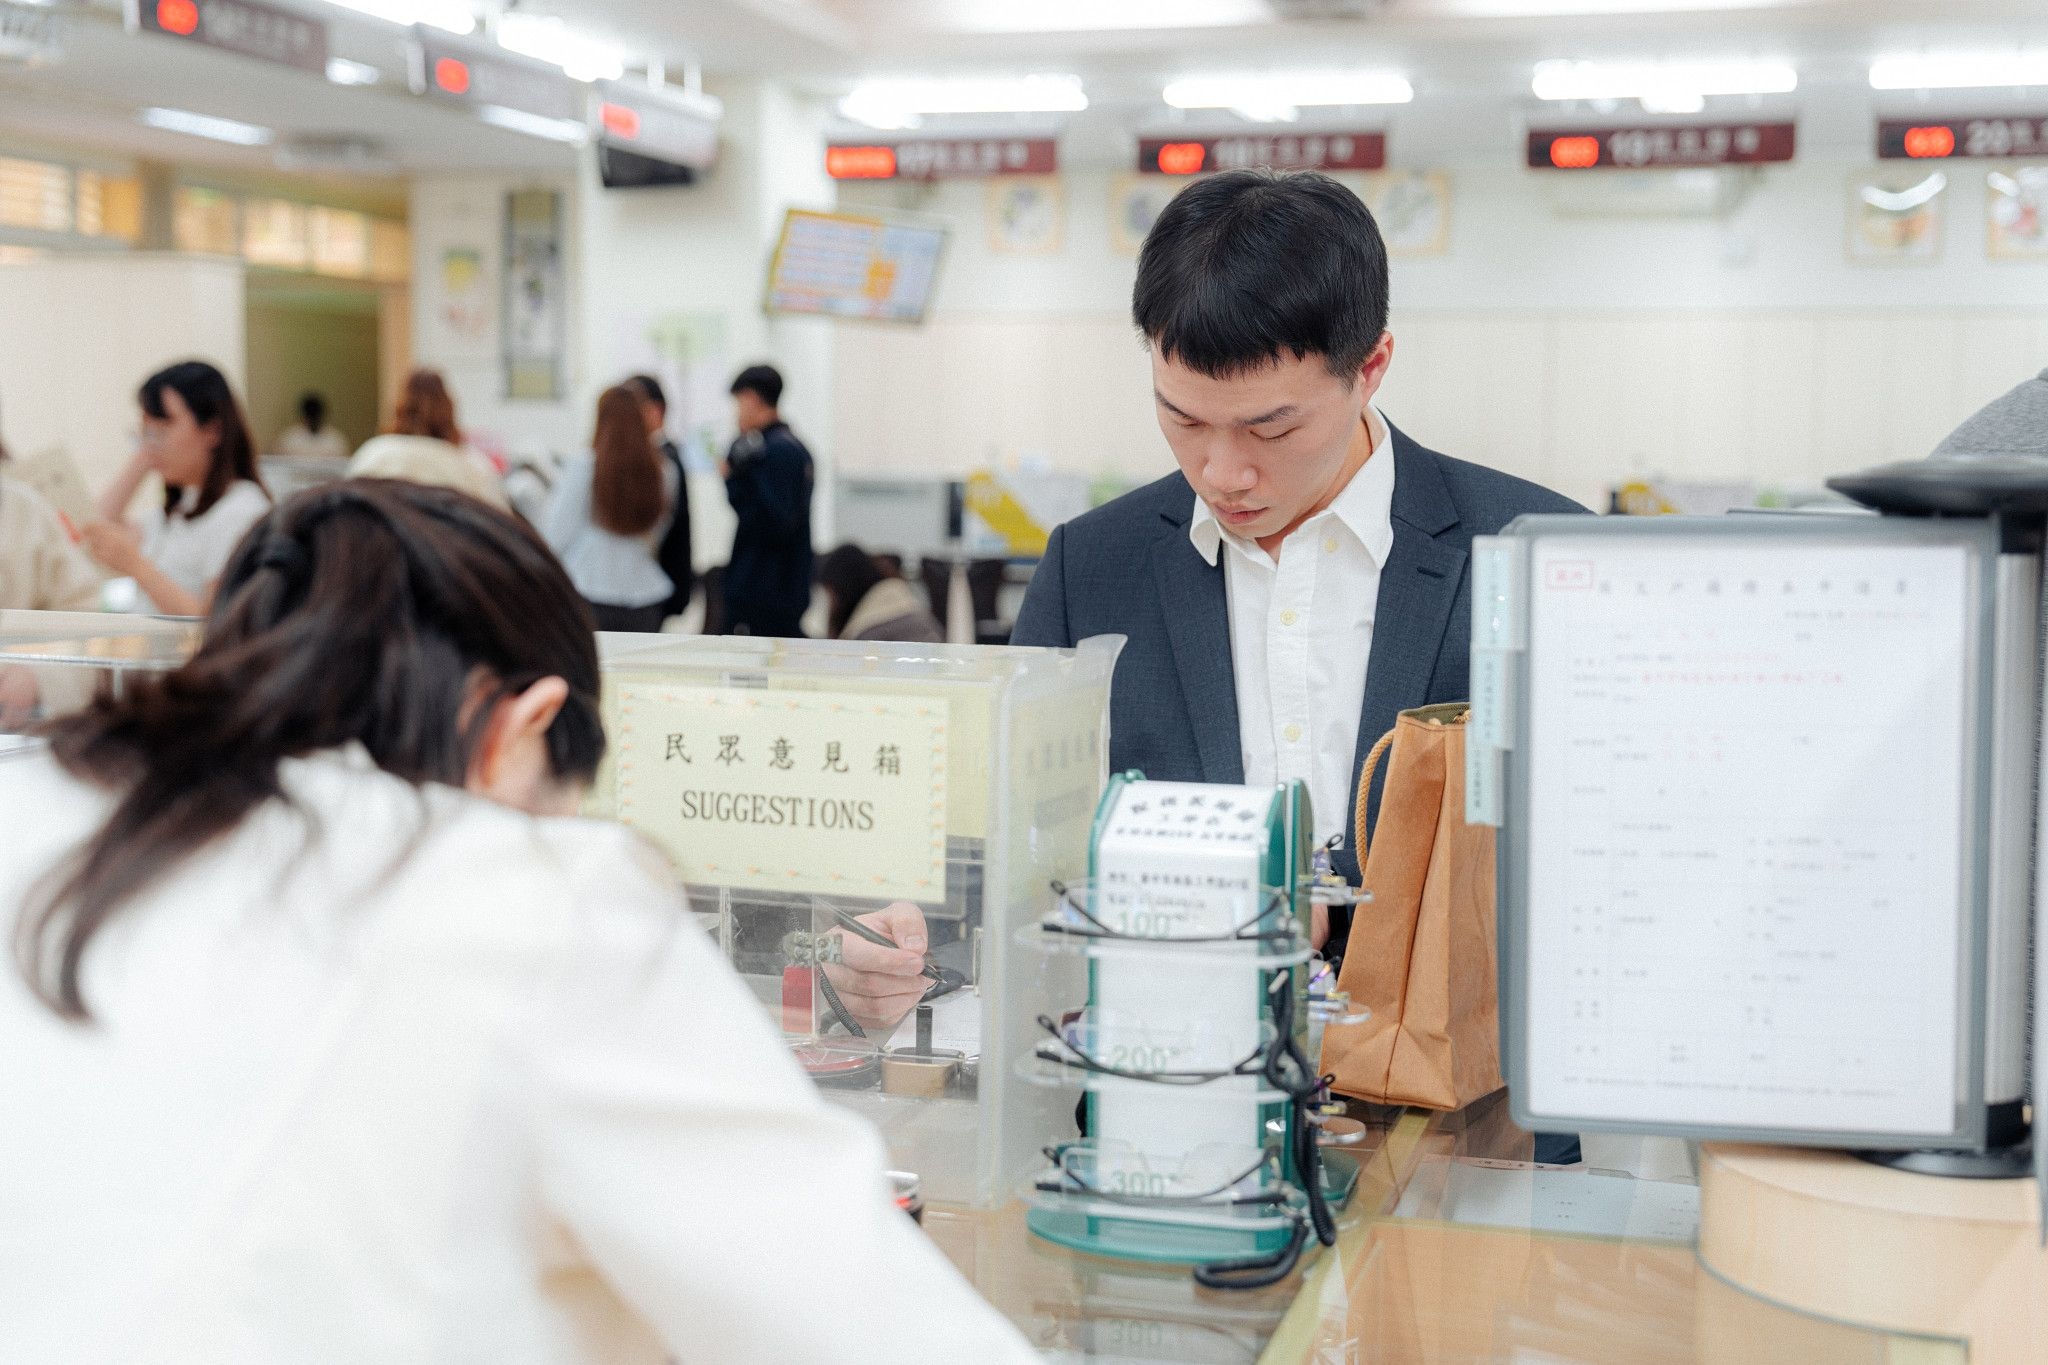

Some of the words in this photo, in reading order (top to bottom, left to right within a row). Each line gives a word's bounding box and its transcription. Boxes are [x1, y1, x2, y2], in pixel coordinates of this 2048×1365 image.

[664, 733, 901, 776] 民眾意見箱
[681, 790, 875, 831] SUGGESTIONS
